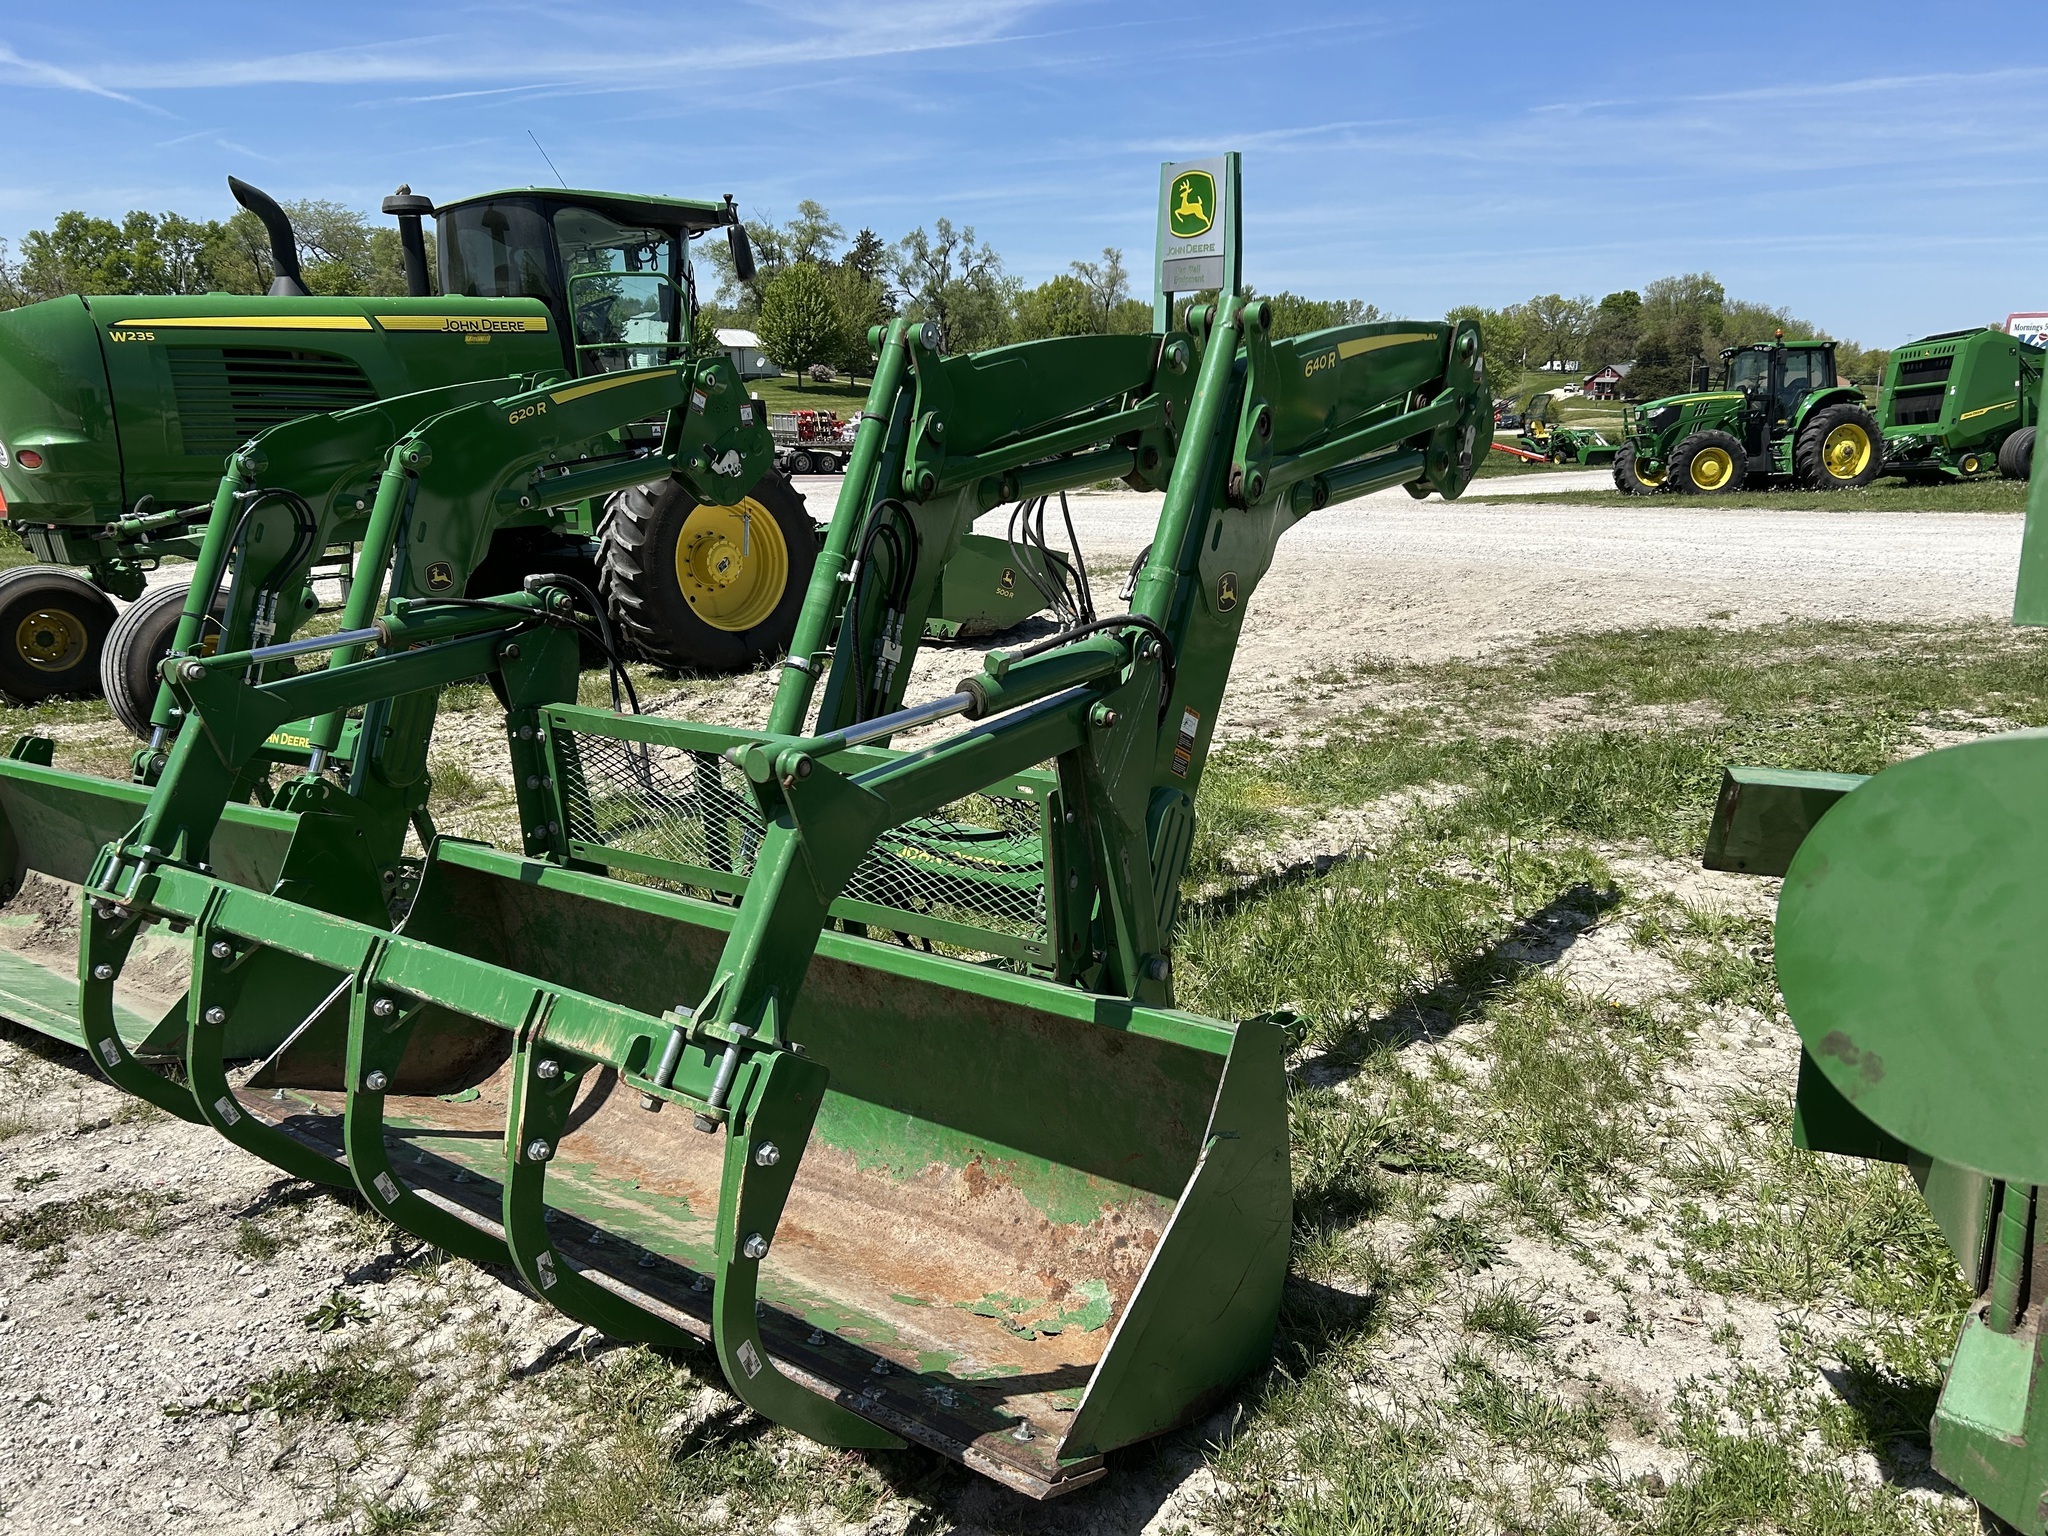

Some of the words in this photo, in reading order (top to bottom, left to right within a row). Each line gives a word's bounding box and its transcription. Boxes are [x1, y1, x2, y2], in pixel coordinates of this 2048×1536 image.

[1166, 246, 1186, 256] JOHN
[1186, 243, 1215, 254] DEERE
[442, 318, 479, 332] JOHN
[481, 318, 526, 333] DEERE
[2013, 323, 2043, 333] Mornings
[109, 331, 156, 342] W235
